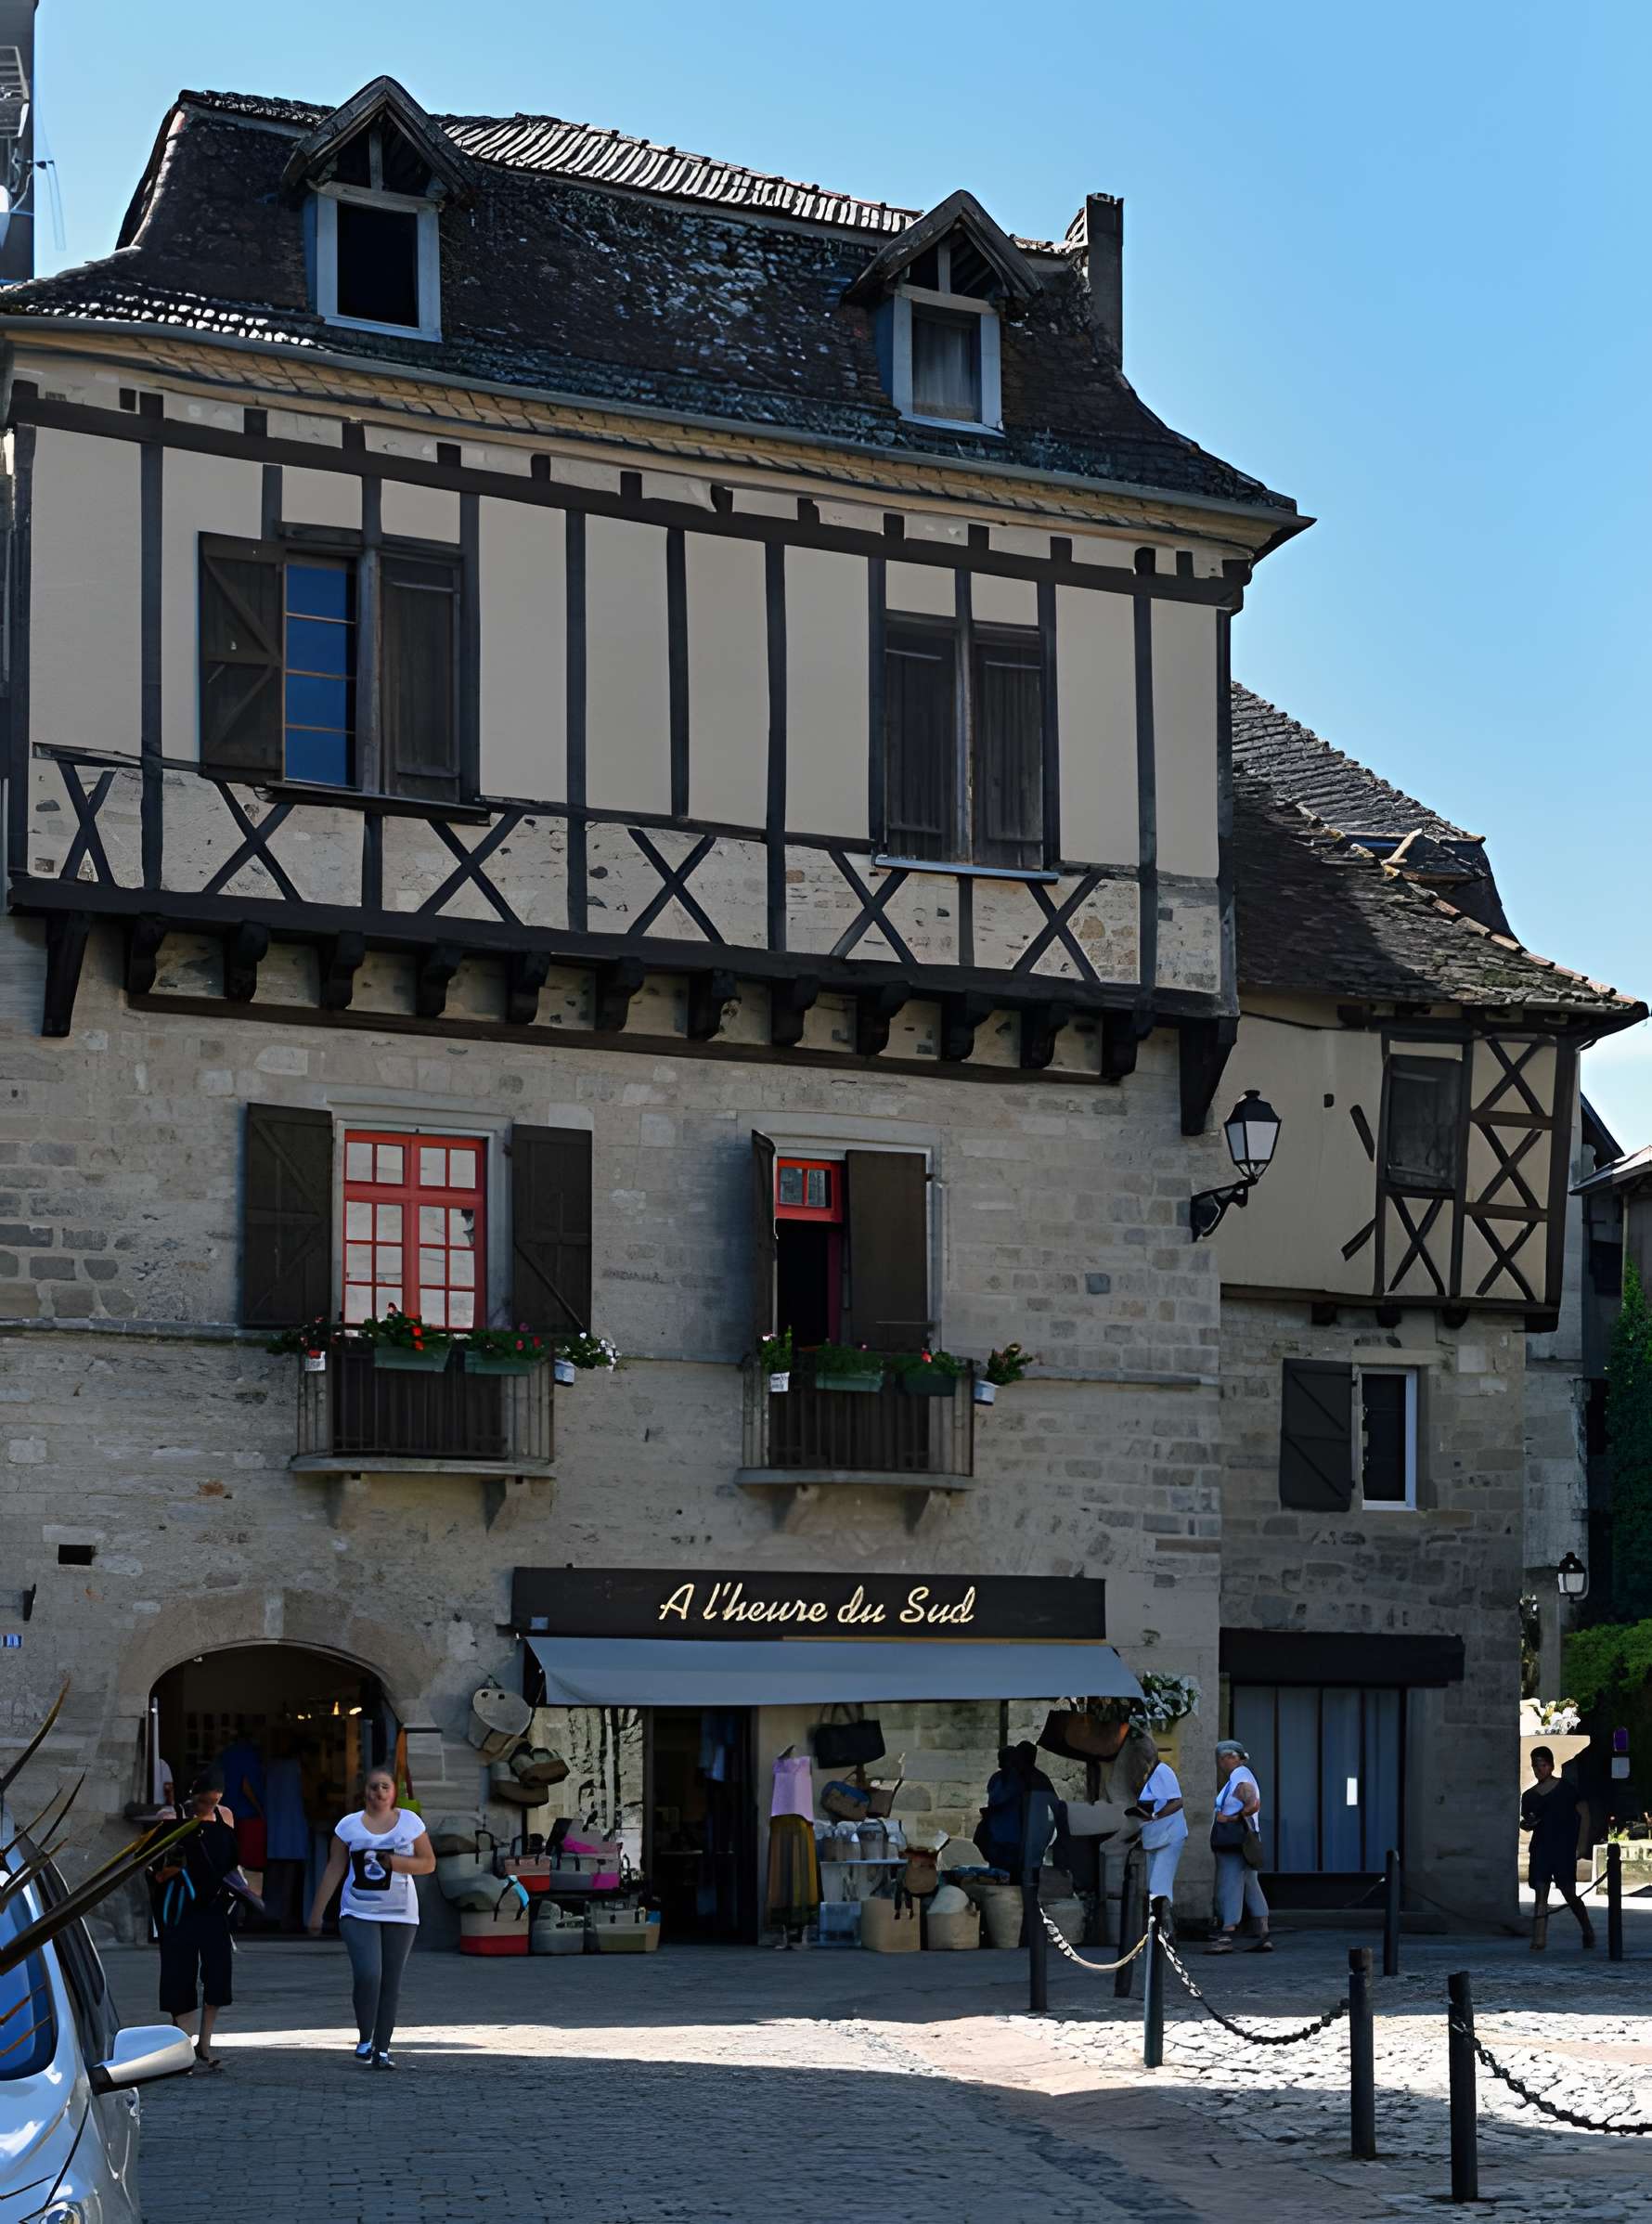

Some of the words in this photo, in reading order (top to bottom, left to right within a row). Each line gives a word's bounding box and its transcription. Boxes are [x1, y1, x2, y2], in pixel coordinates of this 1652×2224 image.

[658, 1583, 695, 1621] A
[702, 1582, 829, 1623] l'heure
[837, 1584, 886, 1623] du
[899, 1585, 975, 1623] Sud
